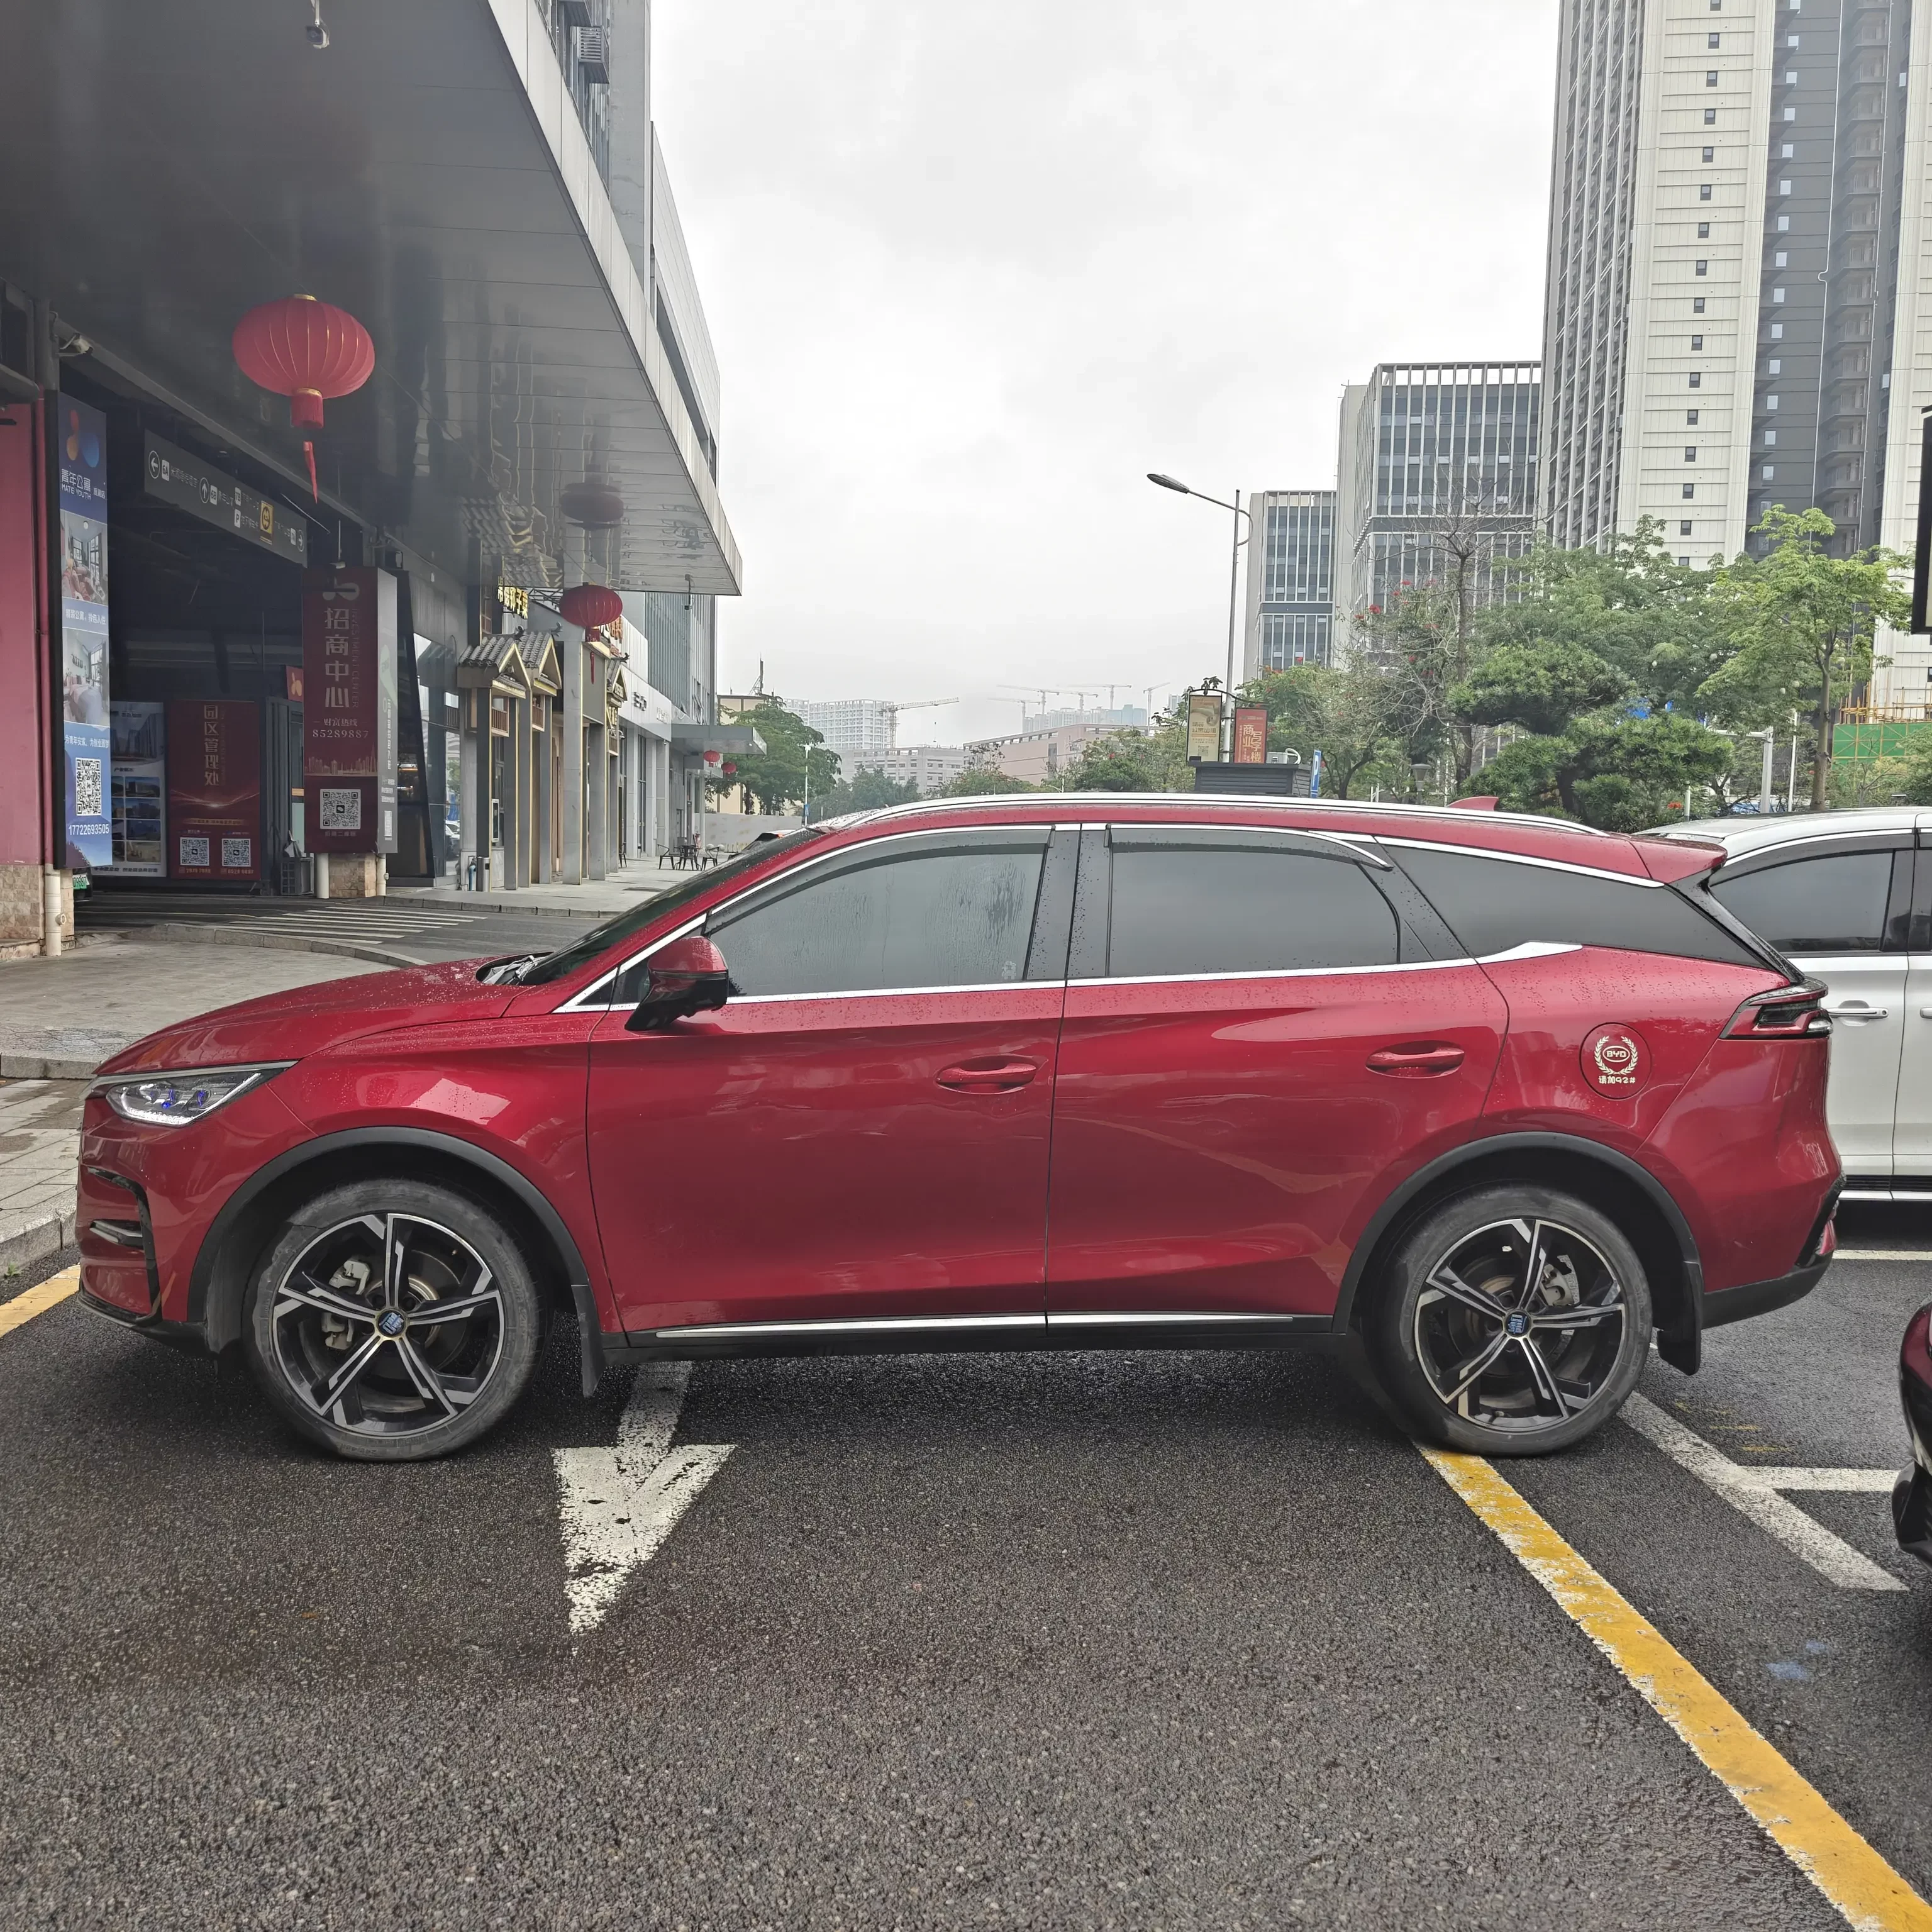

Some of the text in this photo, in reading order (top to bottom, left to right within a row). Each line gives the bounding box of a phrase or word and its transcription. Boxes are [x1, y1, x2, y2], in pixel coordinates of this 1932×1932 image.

[61, 468, 91, 492] 青年公寓
[62, 483, 75, 495] MATE
[75, 488, 92, 501] YOUTH
[325, 608, 350, 708] 招商中心
[204, 705, 219, 786] 园区管理处
[313, 730, 369, 738] 85289887
[1243, 724, 1254, 747] 商业
[1250, 731, 1263, 763] 写字楼
[1312, 755, 1319, 787] P
[69, 824, 109, 835] 17722693505
